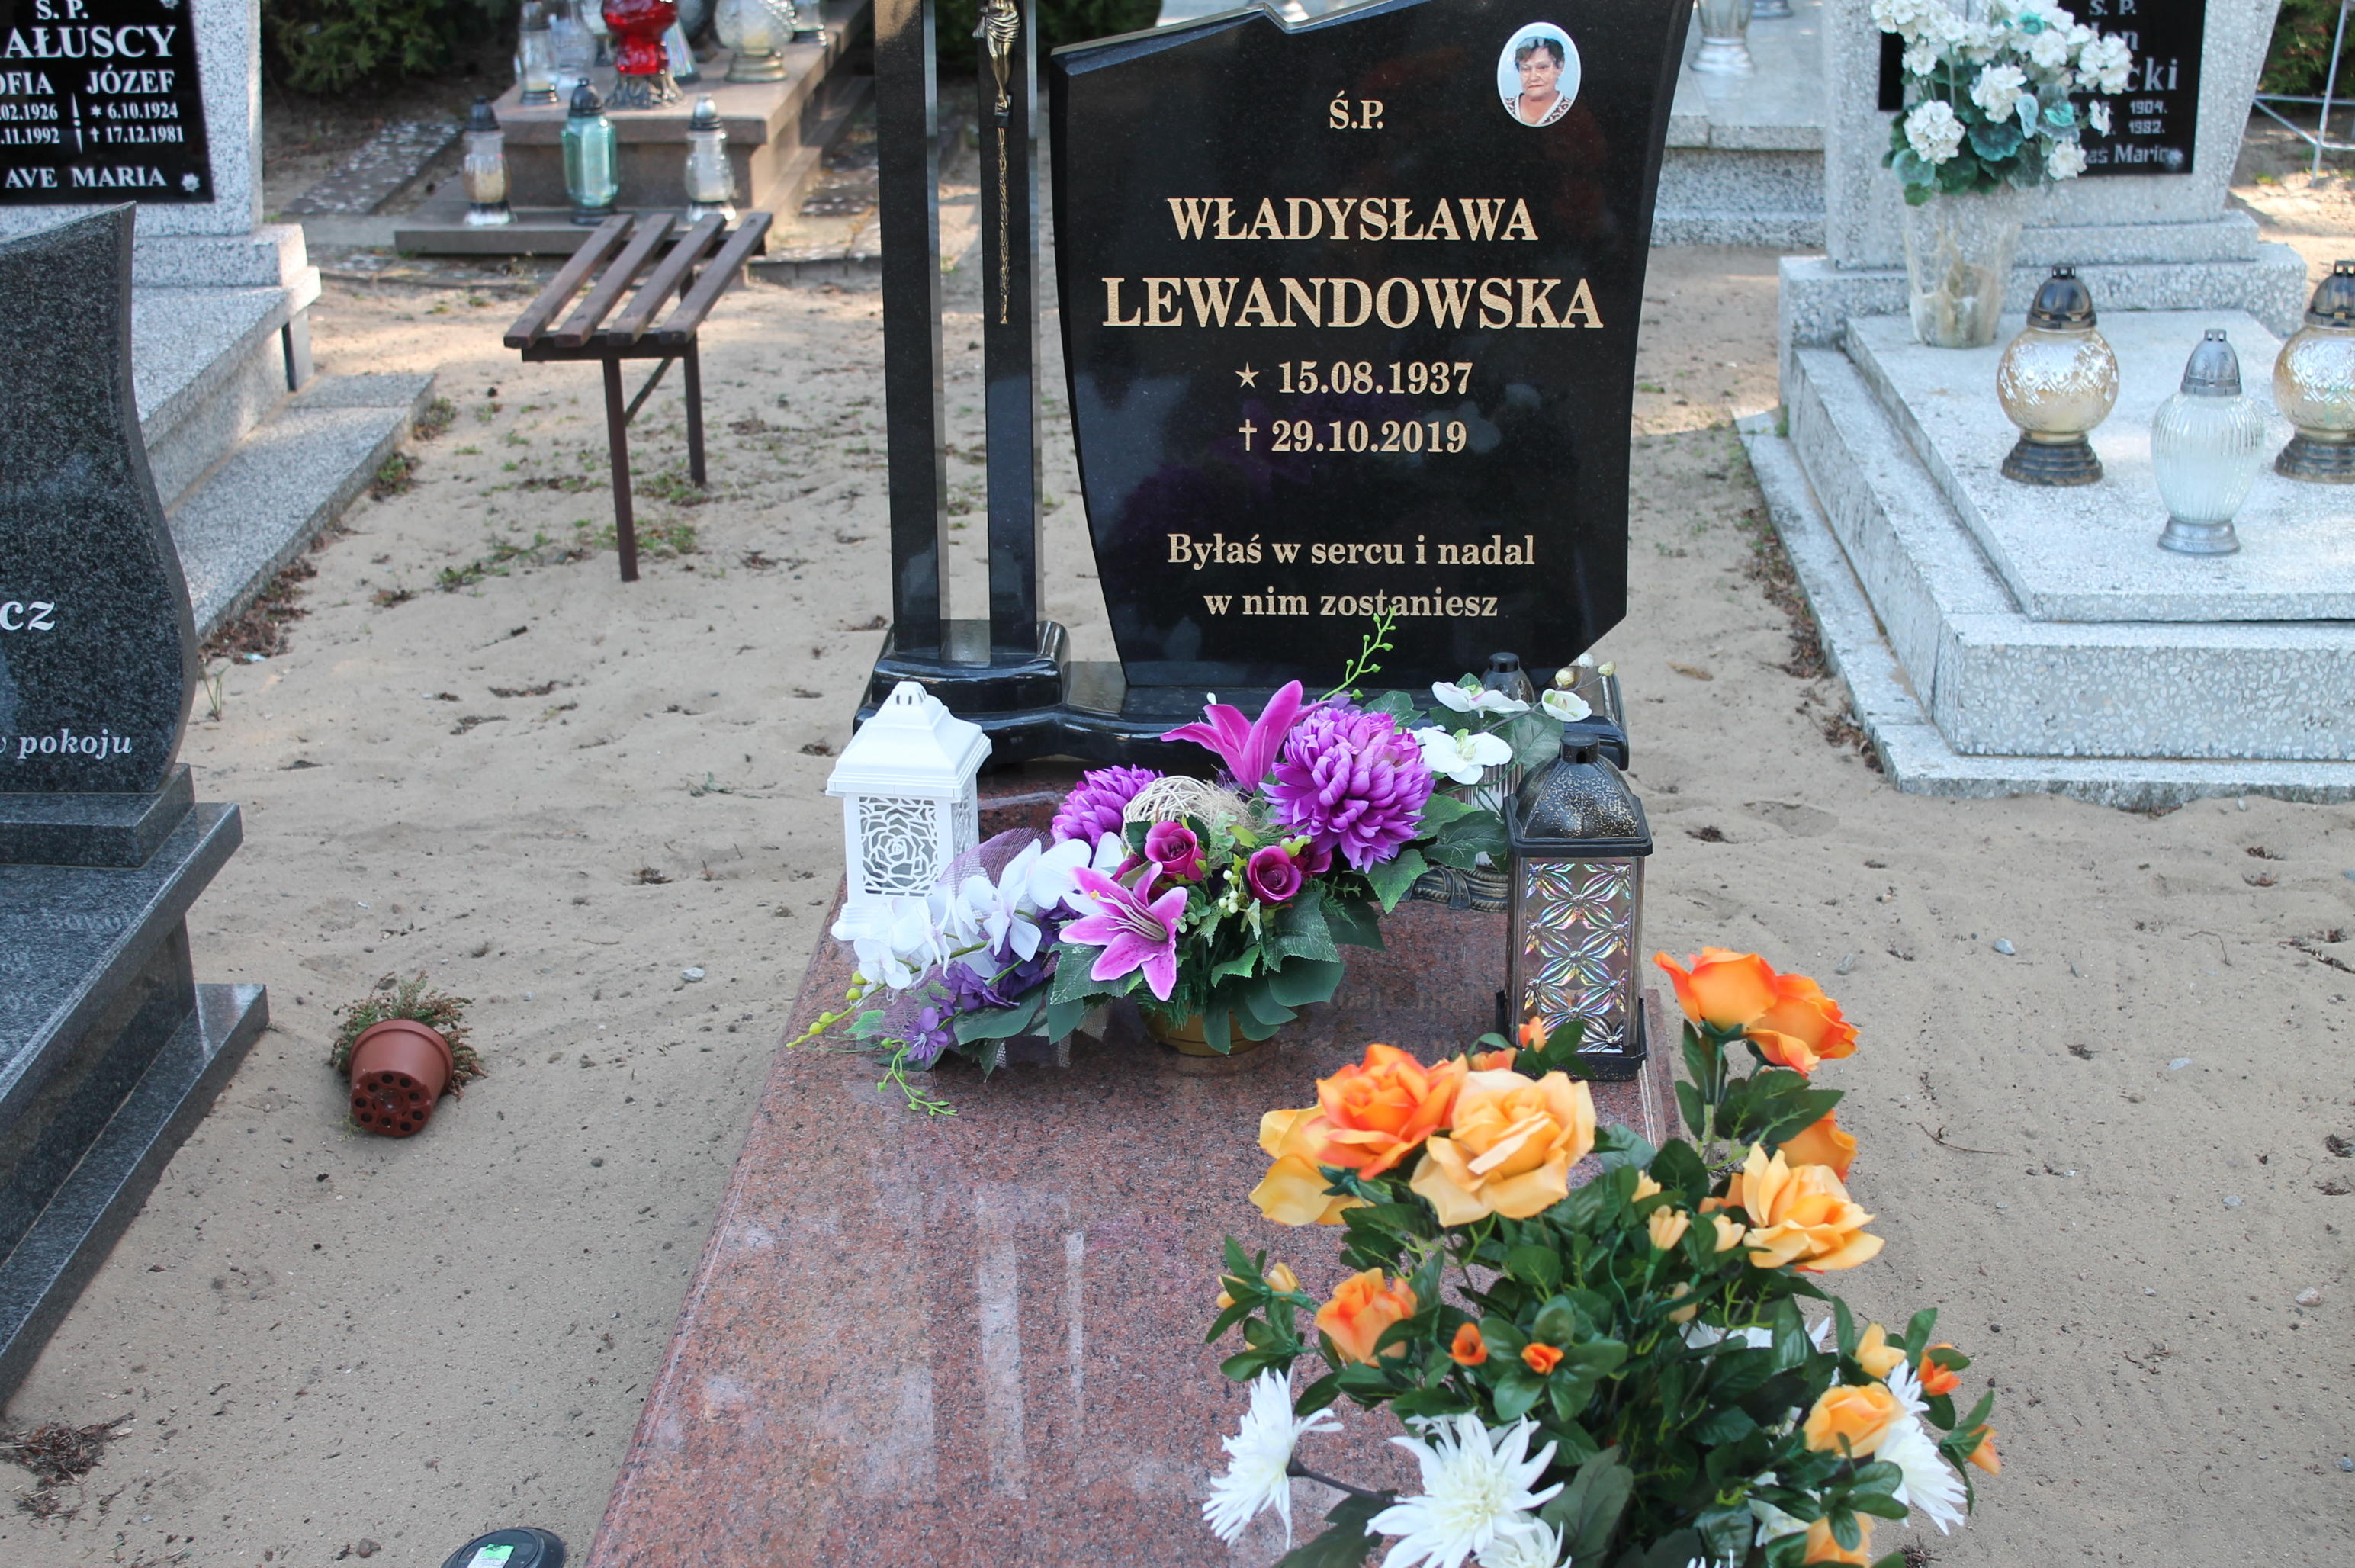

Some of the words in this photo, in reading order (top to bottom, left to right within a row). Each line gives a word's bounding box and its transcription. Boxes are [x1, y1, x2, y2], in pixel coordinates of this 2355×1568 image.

[0, 25, 176, 58] AŁUSCY
[86, 63, 175, 94] JÓZEF
[107, 101, 178, 119] 6.10.1924
[1329, 90, 1384, 130] Ś.P.
[106, 126, 184, 143] 17.12.1981
[5, 167, 58, 188] AVE
[71, 166, 167, 188] MARIA
[1167, 197, 1539, 242] WŁADYSŁAWA
[1101, 277, 1604, 329] LEWANDOWSKA
[1278, 361, 1473, 395] 15.08.1937
[1271, 419, 1467, 454] 29.10.2019
[1167, 532, 1262, 571] Byłaś
[1272, 543, 1301, 564] w
[1311, 543, 1406, 564] sercu
[1416, 534, 1427, 564] i
[1438, 535, 1535, 565] nadal
[1203, 595, 1232, 615] w
[1242, 586, 1309, 615] nim
[1319, 586, 1498, 618] zostaniesz
[17, 728, 133, 760] pokoju
